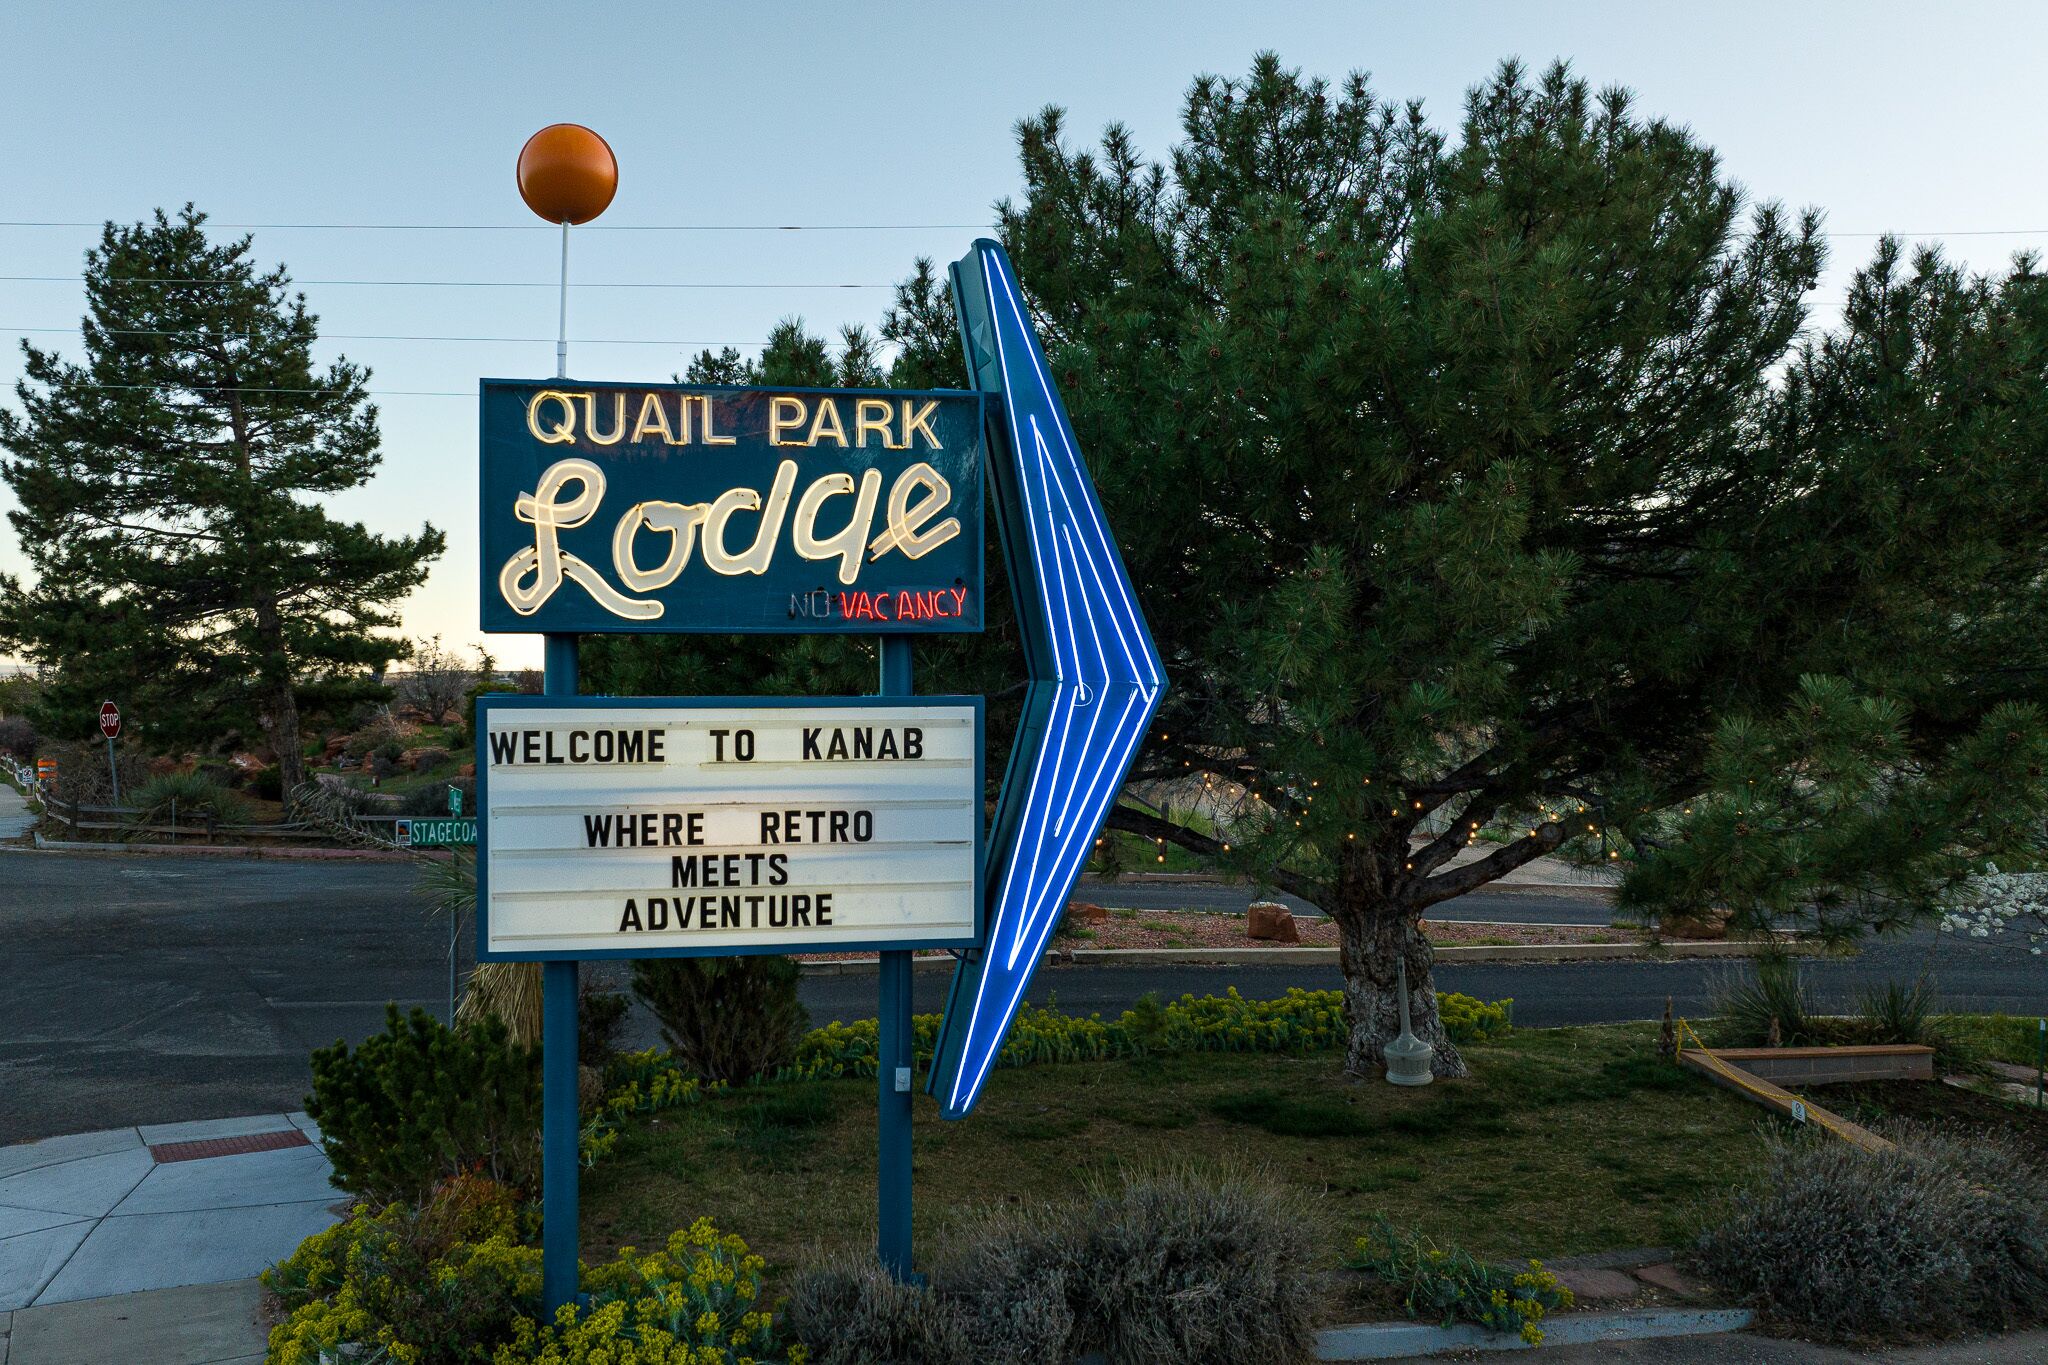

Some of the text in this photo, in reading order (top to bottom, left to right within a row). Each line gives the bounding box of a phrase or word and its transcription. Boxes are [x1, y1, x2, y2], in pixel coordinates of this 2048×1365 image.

[527, 390, 944, 449] QUAIL PARK
[499, 457, 961, 620] Lodge
[791, 590, 830, 617] NO
[102, 713, 119, 727] STOP
[490, 727, 924, 764] WELCOME TO KANAB
[584, 810, 873, 848] WHERE RETRO
[672, 853, 788, 888] MEETS
[619, 893, 833, 931] ADVENTURE
